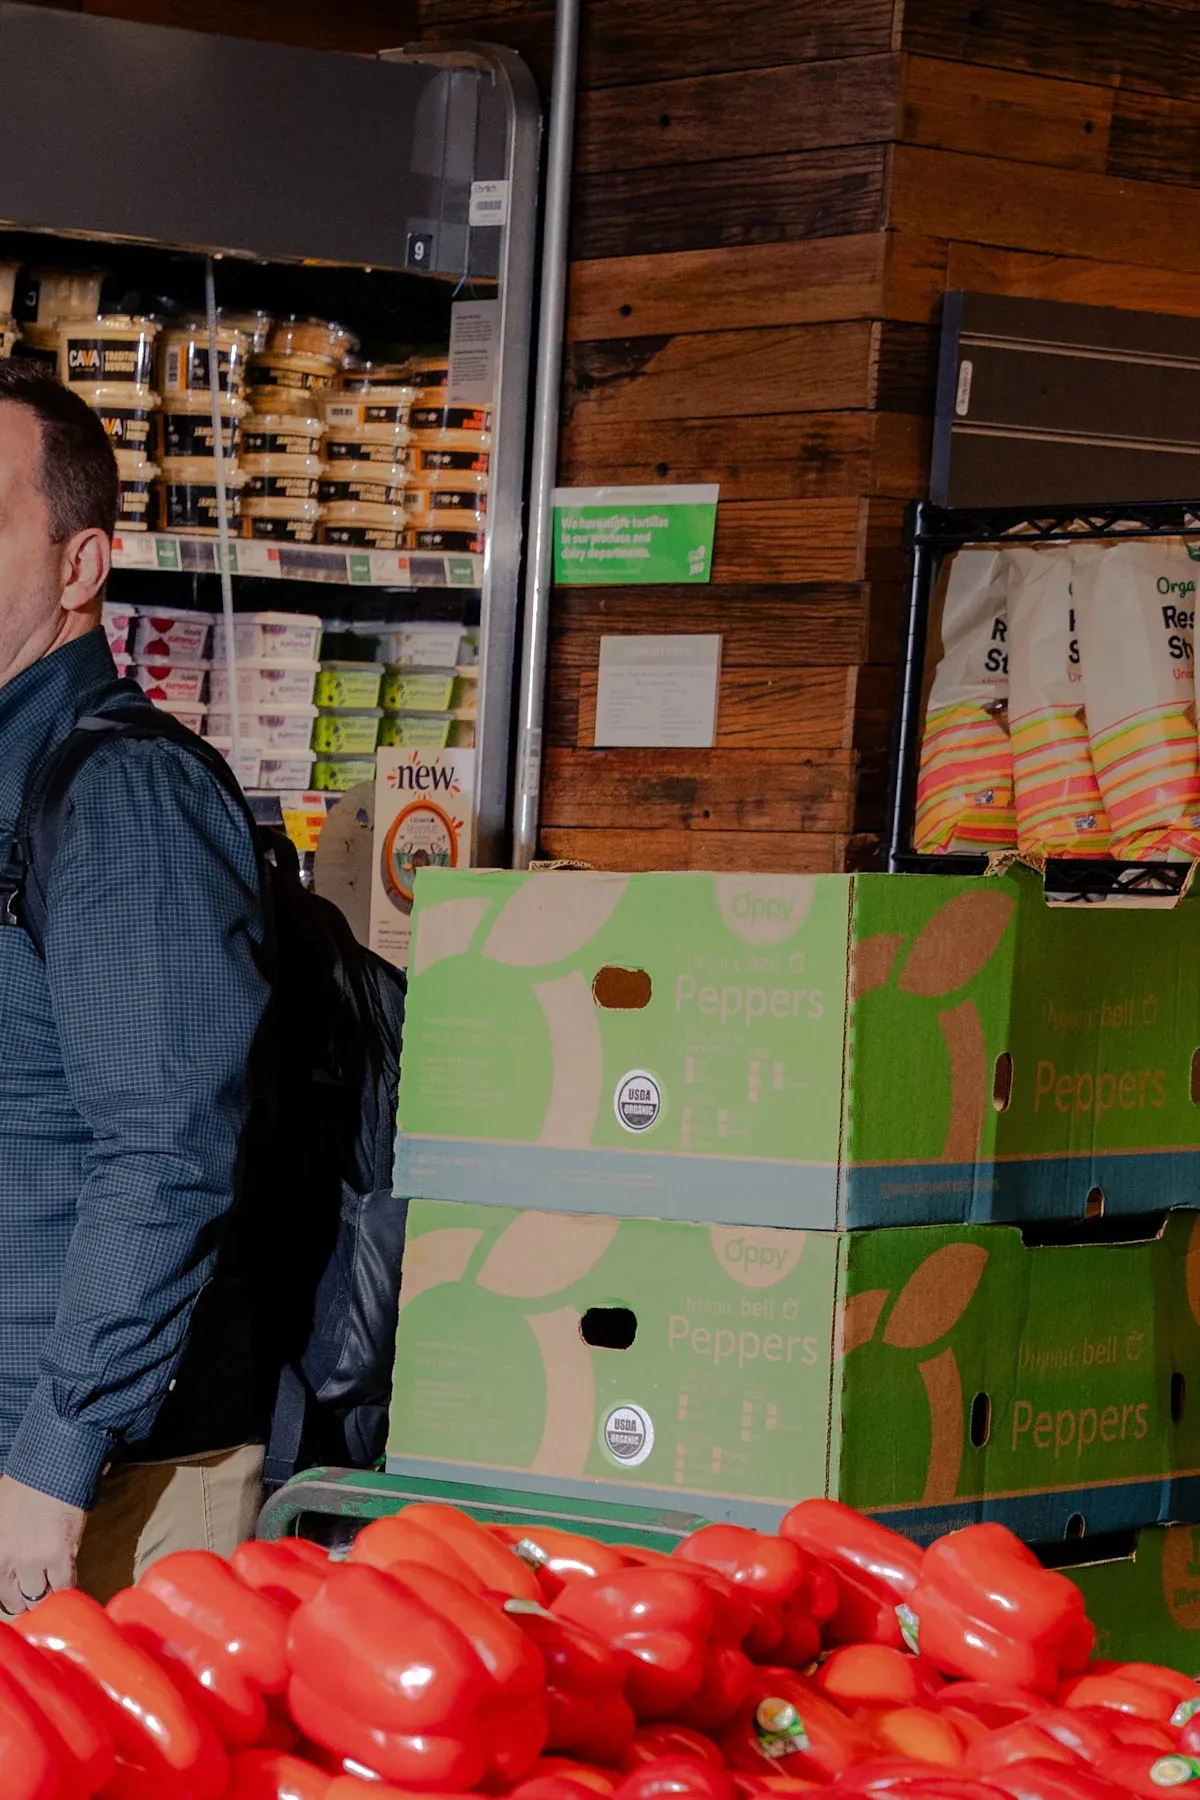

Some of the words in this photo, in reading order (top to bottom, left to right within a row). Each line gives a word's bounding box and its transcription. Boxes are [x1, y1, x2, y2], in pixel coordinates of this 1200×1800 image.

[414, 241, 424, 261] 9
[398, 765, 454, 791] new
[732, 892, 793, 925] Oppy
[675, 973, 824, 1027] Peppers
[629, 1089, 651, 1101] USDA
[1033, 1060, 1167, 1121] Peppers
[624, 1104, 654, 1115] ORGANIC
[725, 1237, 788, 1271] Oppy
[741, 1299, 773, 1319] bell
[667, 1314, 819, 1368] Peppers
[1082, 1336, 1118, 1366] bell
[614, 1419, 636, 1431] USDA
[1011, 1400, 1150, 1459] Peppers
[610, 1434, 639, 1445] ORGANIC
